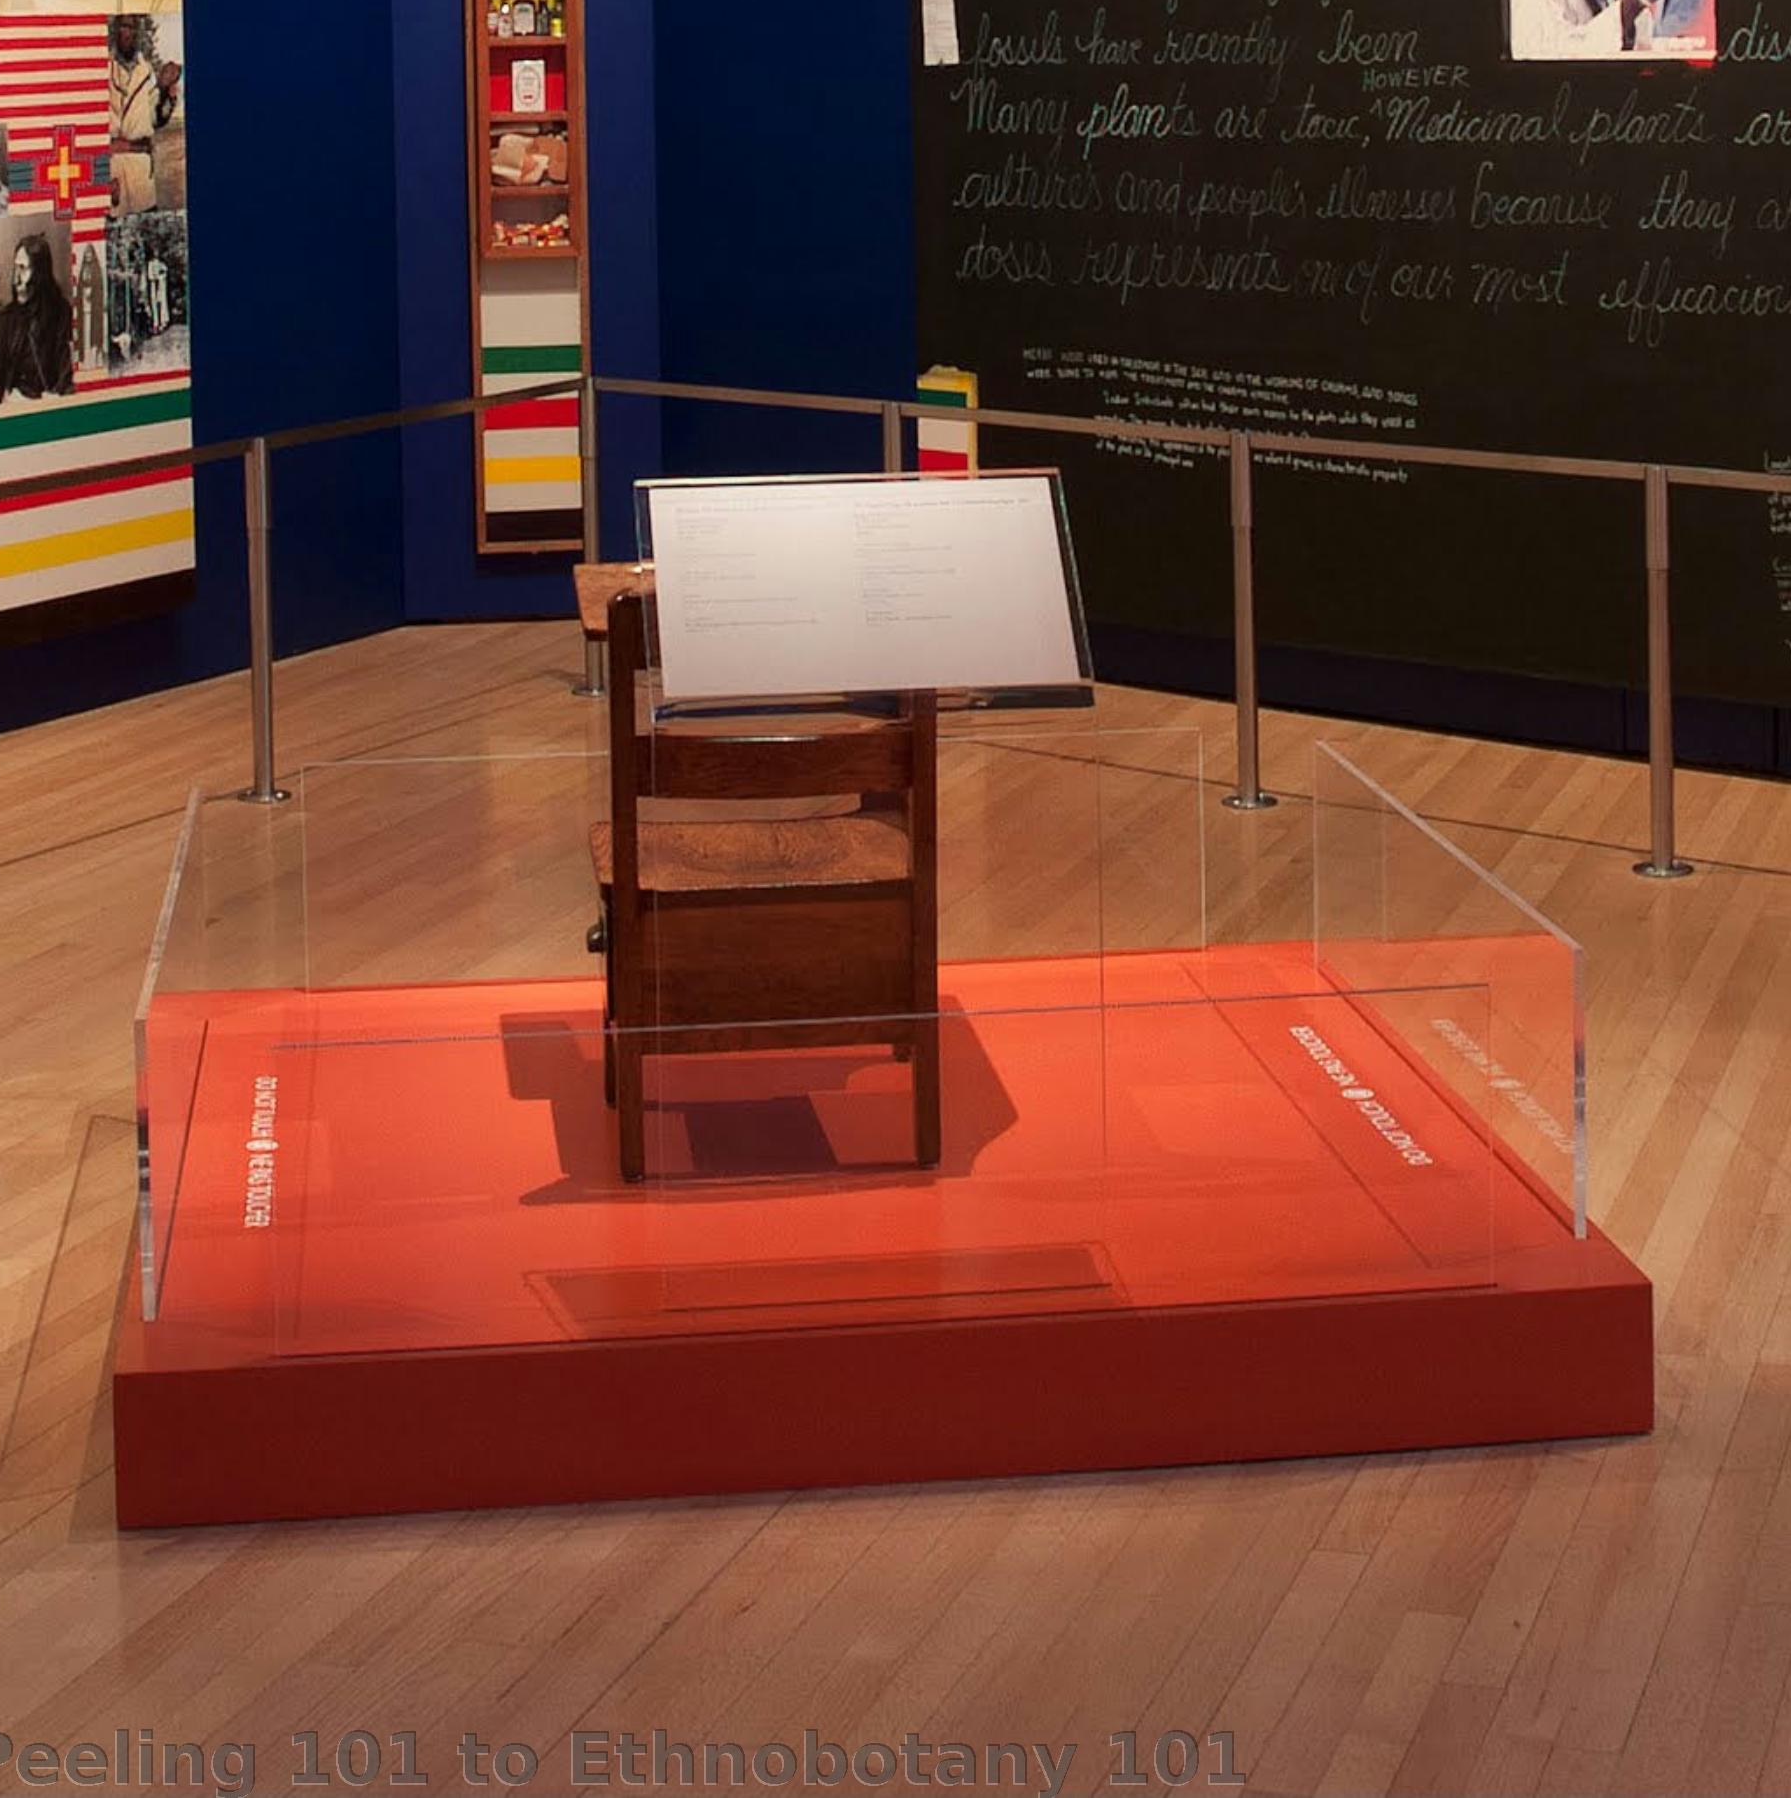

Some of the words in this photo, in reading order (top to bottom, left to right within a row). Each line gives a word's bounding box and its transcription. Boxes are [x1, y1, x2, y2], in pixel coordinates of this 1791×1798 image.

[1075, 6, 1142, 65] have
[1316, 8, 1422, 64] been
[1076, 82, 1203, 161] plants
[1569, 88, 1714, 166] plants
